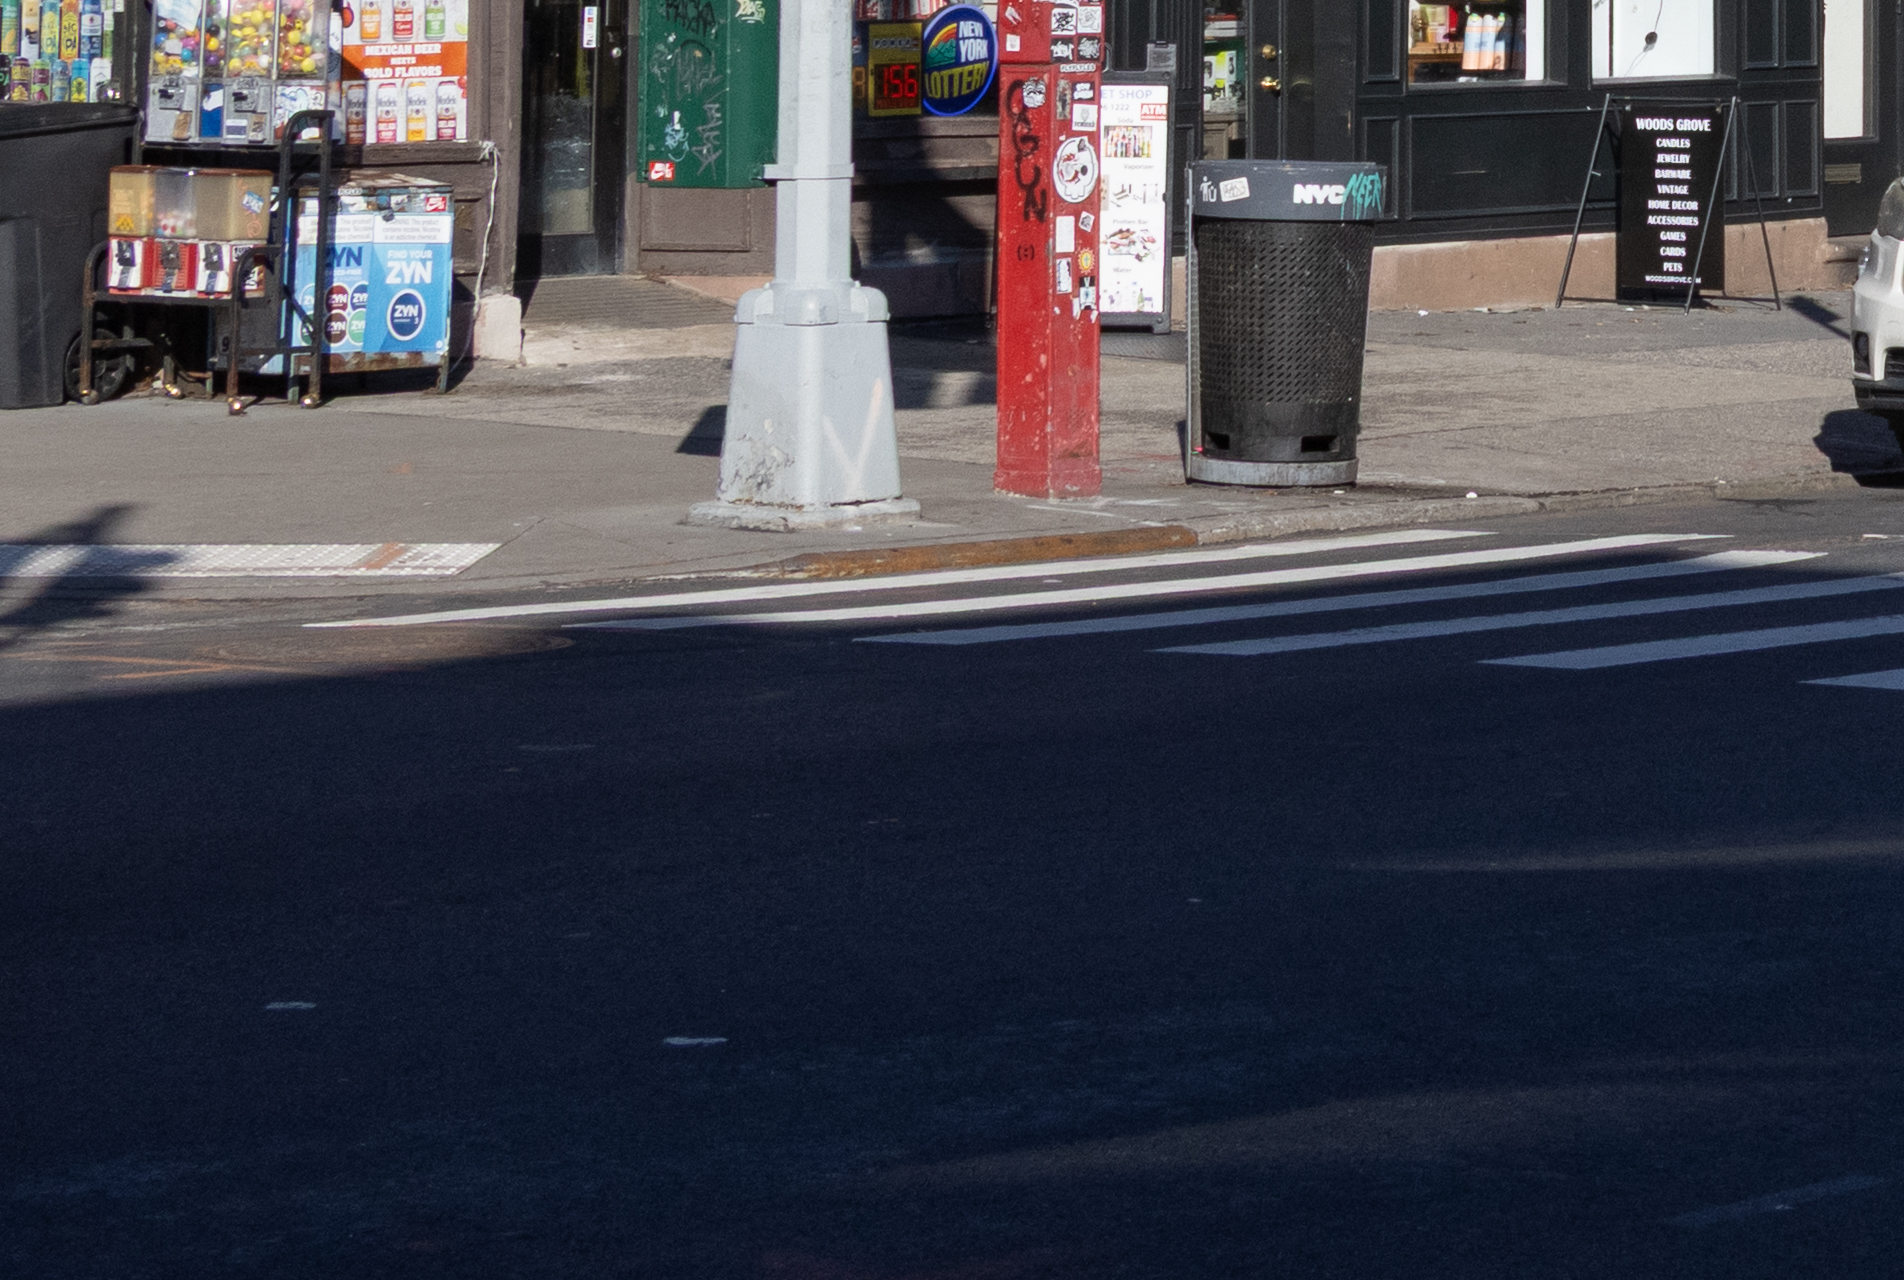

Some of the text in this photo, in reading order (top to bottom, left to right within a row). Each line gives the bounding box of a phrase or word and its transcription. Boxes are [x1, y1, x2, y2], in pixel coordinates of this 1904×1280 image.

[958, 20, 984, 39] NEW
[364, 43, 442, 57] MEXICAN BEER
[958, 38, 989, 63] YORK
[364, 65, 443, 79] BOLD FLAVORS
[883, 64, 919, 98] 156
[924, 60, 990, 99] LOTTERY
[1118, 89, 1153, 100] SHOP
[1142, 104, 1167, 116] ATM
[1635, 117, 1711, 132] WOODS GROVE
[1656, 138, 1691, 149] CANDLES
[1656, 153, 1691, 164] JEWELRY
[1654, 169, 1692, 180] BARWARE
[1293, 183, 1347, 205] NYC
[1657, 184, 1689, 195] VINTAGE
[1647, 199, 1699, 211] HOME DECOR
[1647, 215, 1700, 227] ACCESSORIES
[1659, 231, 1687, 242] GAMES
[387, 249, 433, 259] FIND YOUR
[1659, 246, 1687, 257] CARDS
[385, 260, 433, 285] ZYN
[1663, 262, 1683, 273] PETS
[1645, 274, 1702, 285] WOODSGROVE.CM
[393, 304, 419, 318] ZYN
